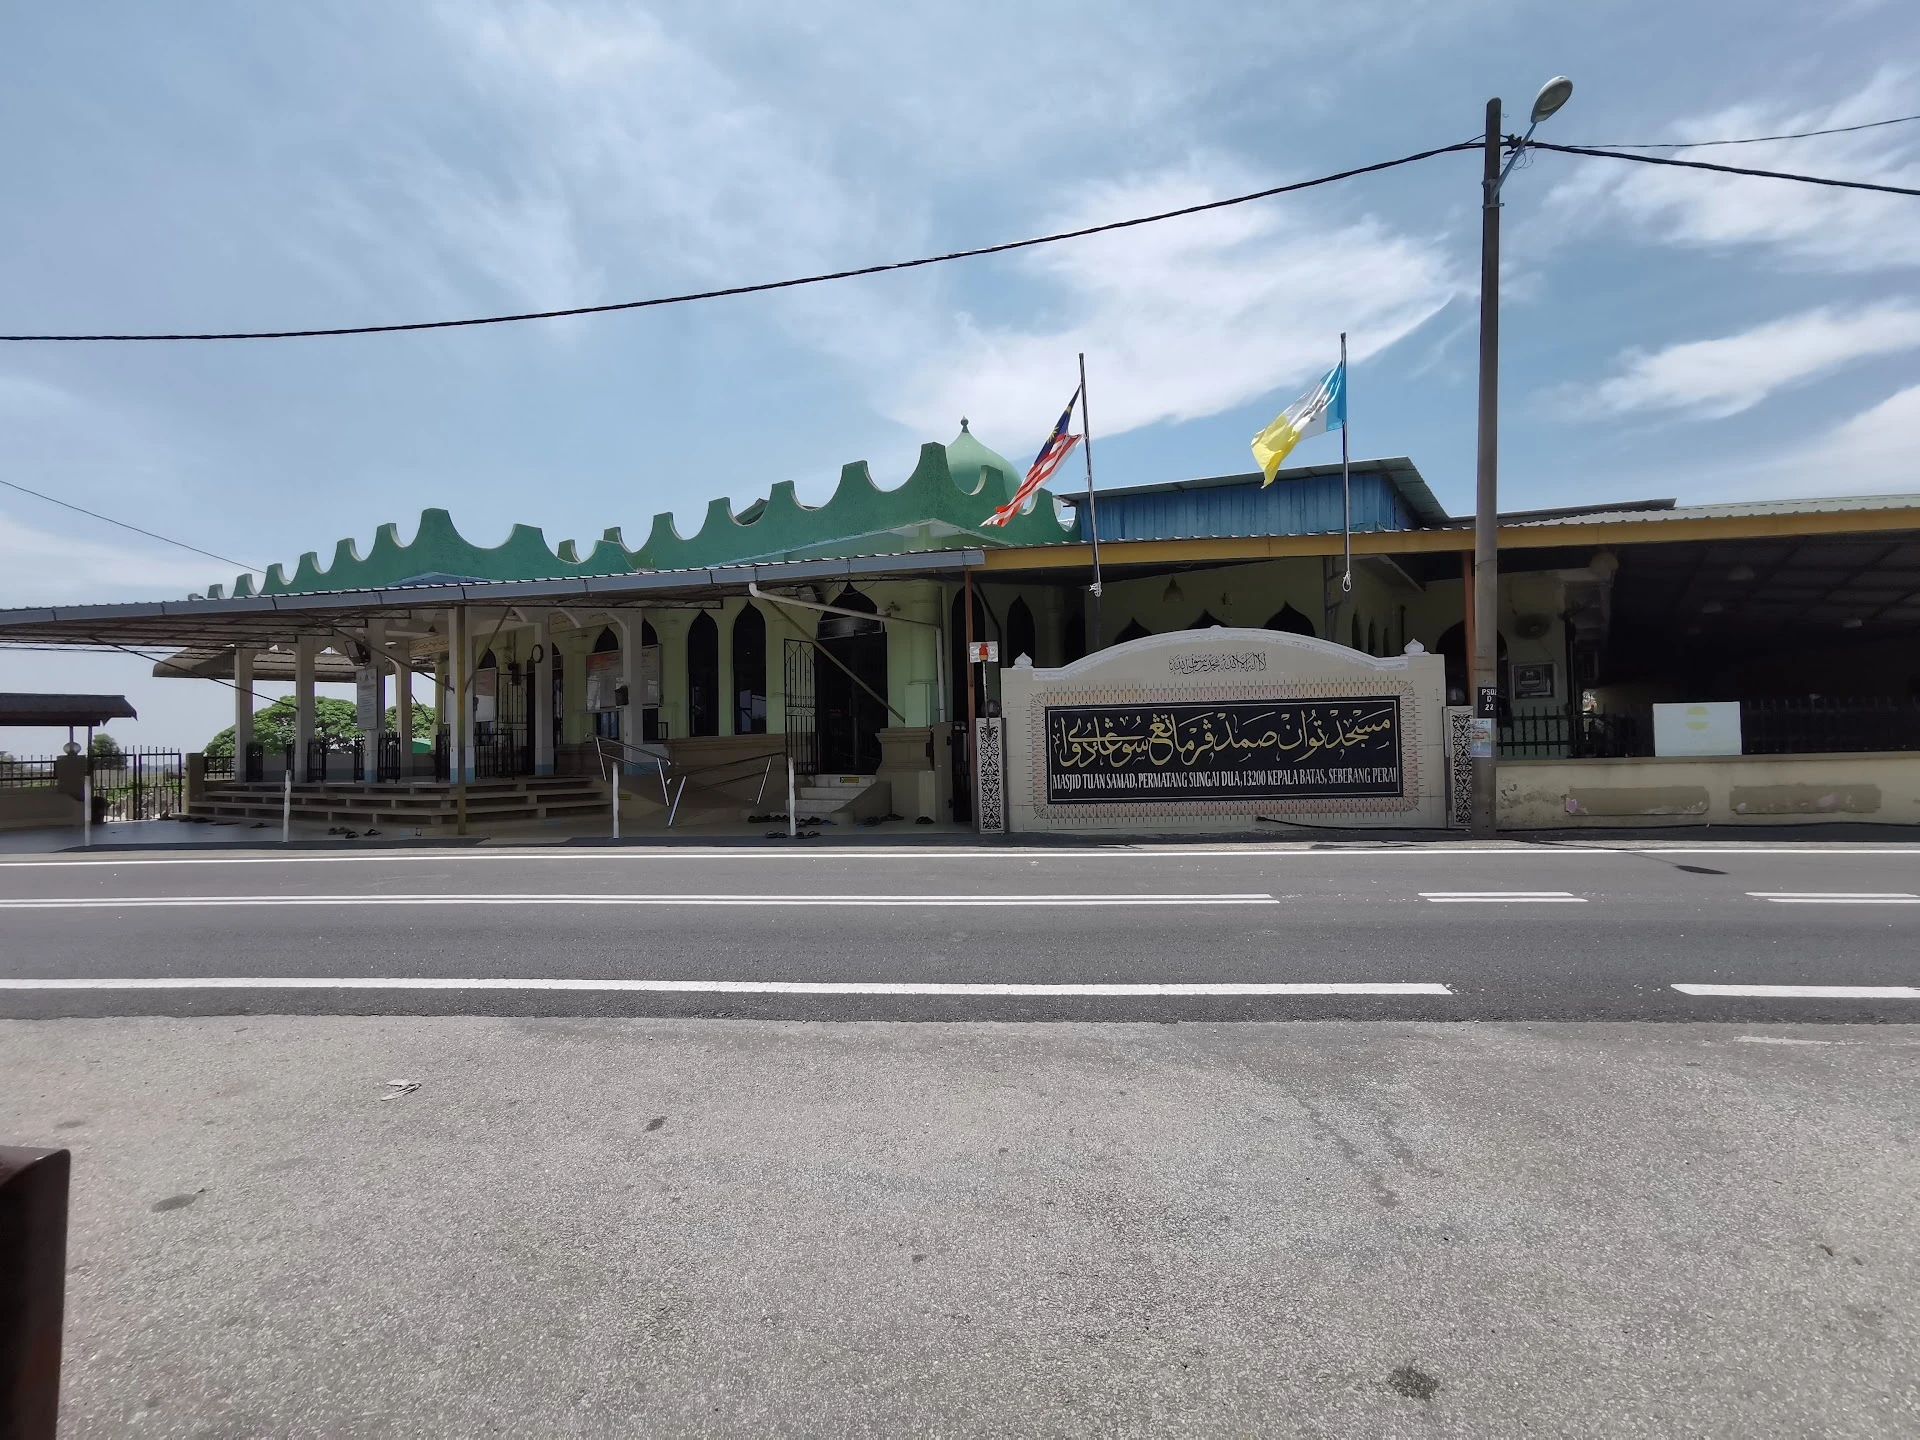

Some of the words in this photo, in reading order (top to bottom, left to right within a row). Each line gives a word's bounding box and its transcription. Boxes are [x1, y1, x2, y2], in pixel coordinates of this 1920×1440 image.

[1484, 703, 1494, 711] 22
[1052, 773, 1082, 792] MASJID
[1083, 773, 1106, 789] TUAN
[1106, 773, 1138, 790] SAMAD,
[1138, 771, 1188, 788] PERMATANG
[1189, 771, 1220, 787] SUNGAI
[1242, 770, 1266, 786] 13200
[1267, 769, 1299, 785] KEPALA
[1299, 768, 1328, 785] BATAS,
[1328, 767, 1371, 784] SEBERANG
[1372, 766, 1397, 783] PERAI
